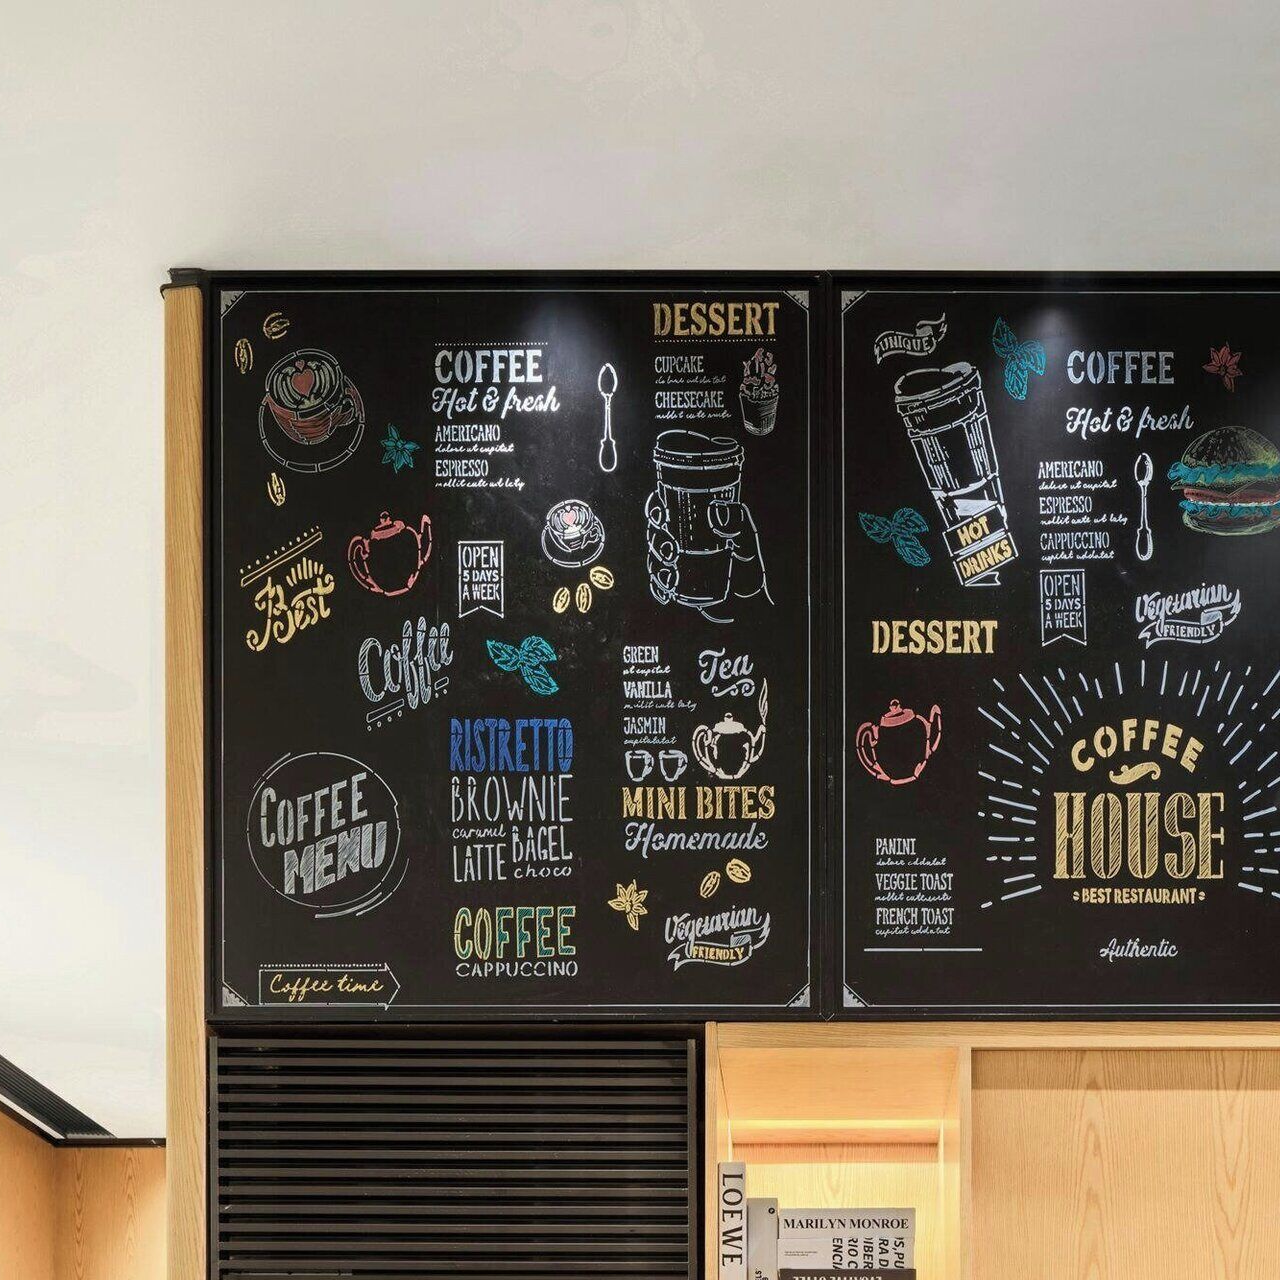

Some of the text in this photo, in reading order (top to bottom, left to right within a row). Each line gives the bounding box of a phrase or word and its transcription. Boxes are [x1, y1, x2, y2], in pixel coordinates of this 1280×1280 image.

[653, 303, 779, 336] DESSERT
[879, 334, 931, 354] UNIQUE
[435, 349, 544, 383] COFFEE
[655, 356, 704, 373] CUPCAKE
[1065, 348, 1174, 384] COFFEE
[432, 386, 560, 419] Hot & fresh
[655, 391, 724, 408] CHEESECAKE
[435, 425, 500, 442] AMERICANO
[1066, 405, 1194, 440] Hot & fresh
[436, 459, 488, 477] ESPRESSO
[1038, 461, 1103, 479] AMERICANO
[1039, 496, 1092, 514] ESPRESSO
[958, 519, 990, 544] HOT
[1040, 532, 1109, 550] CAPPUCCINO
[460, 545, 498, 571] OPEN
[961, 543, 1012, 579] DRINKS
[463, 570, 499, 582] 5 DAYS
[1042, 574, 1080, 598] OPEN
[463, 583, 502, 602] A WEEK
[1046, 598, 1081, 610] 5 DAYS
[1137, 583, 1235, 625] Vegetarian
[1043, 612, 1082, 629] A WEEK
[1162, 624, 1217, 638] FRIENDLY
[872, 620, 997, 654] DESSERT
[359, 617, 455, 708] Coffee
[623, 646, 658, 663] GREEN
[699, 648, 754, 686] Tea
[624, 681, 672, 698] VANILLA
[624, 717, 665, 734] JASMIN
[450, 718, 573, 772] RISTRETTO
[1072, 718, 1204, 775] COFFEE
[452, 774, 573, 822] BROWNIE
[622, 786, 775, 819] MINI BITES
[260, 773, 368, 848] COFFEE
[452, 824, 506, 839] caramel
[512, 825, 573, 862] BAGEL
[624, 822, 769, 859] Homemade
[1054, 792, 1224, 880] HOUSE
[284, 820, 387, 895] MENU
[876, 838, 916, 855] PANINI
[453, 844, 507, 882] LATTE
[513, 861, 571, 878] choco
[875, 873, 953, 890] VEGGIE TOAST
[1082, 888, 1196, 904] BEST RESTAURANT
[665, 906, 762, 945] Vegetarian
[877, 908, 954, 925] FRENCH TOAST
[453, 906, 577, 958] COFFEE
[691, 945, 746, 962] FRIENDLY
[1100, 937, 1179, 960] Authentic
[456, 961, 578, 977] CAPPUCCINO
[270, 974, 384, 1002] Coffee time
[722, 1173, 743, 1267] LOEWE
[783, 1218, 909, 1229] MARILYN MONROE
